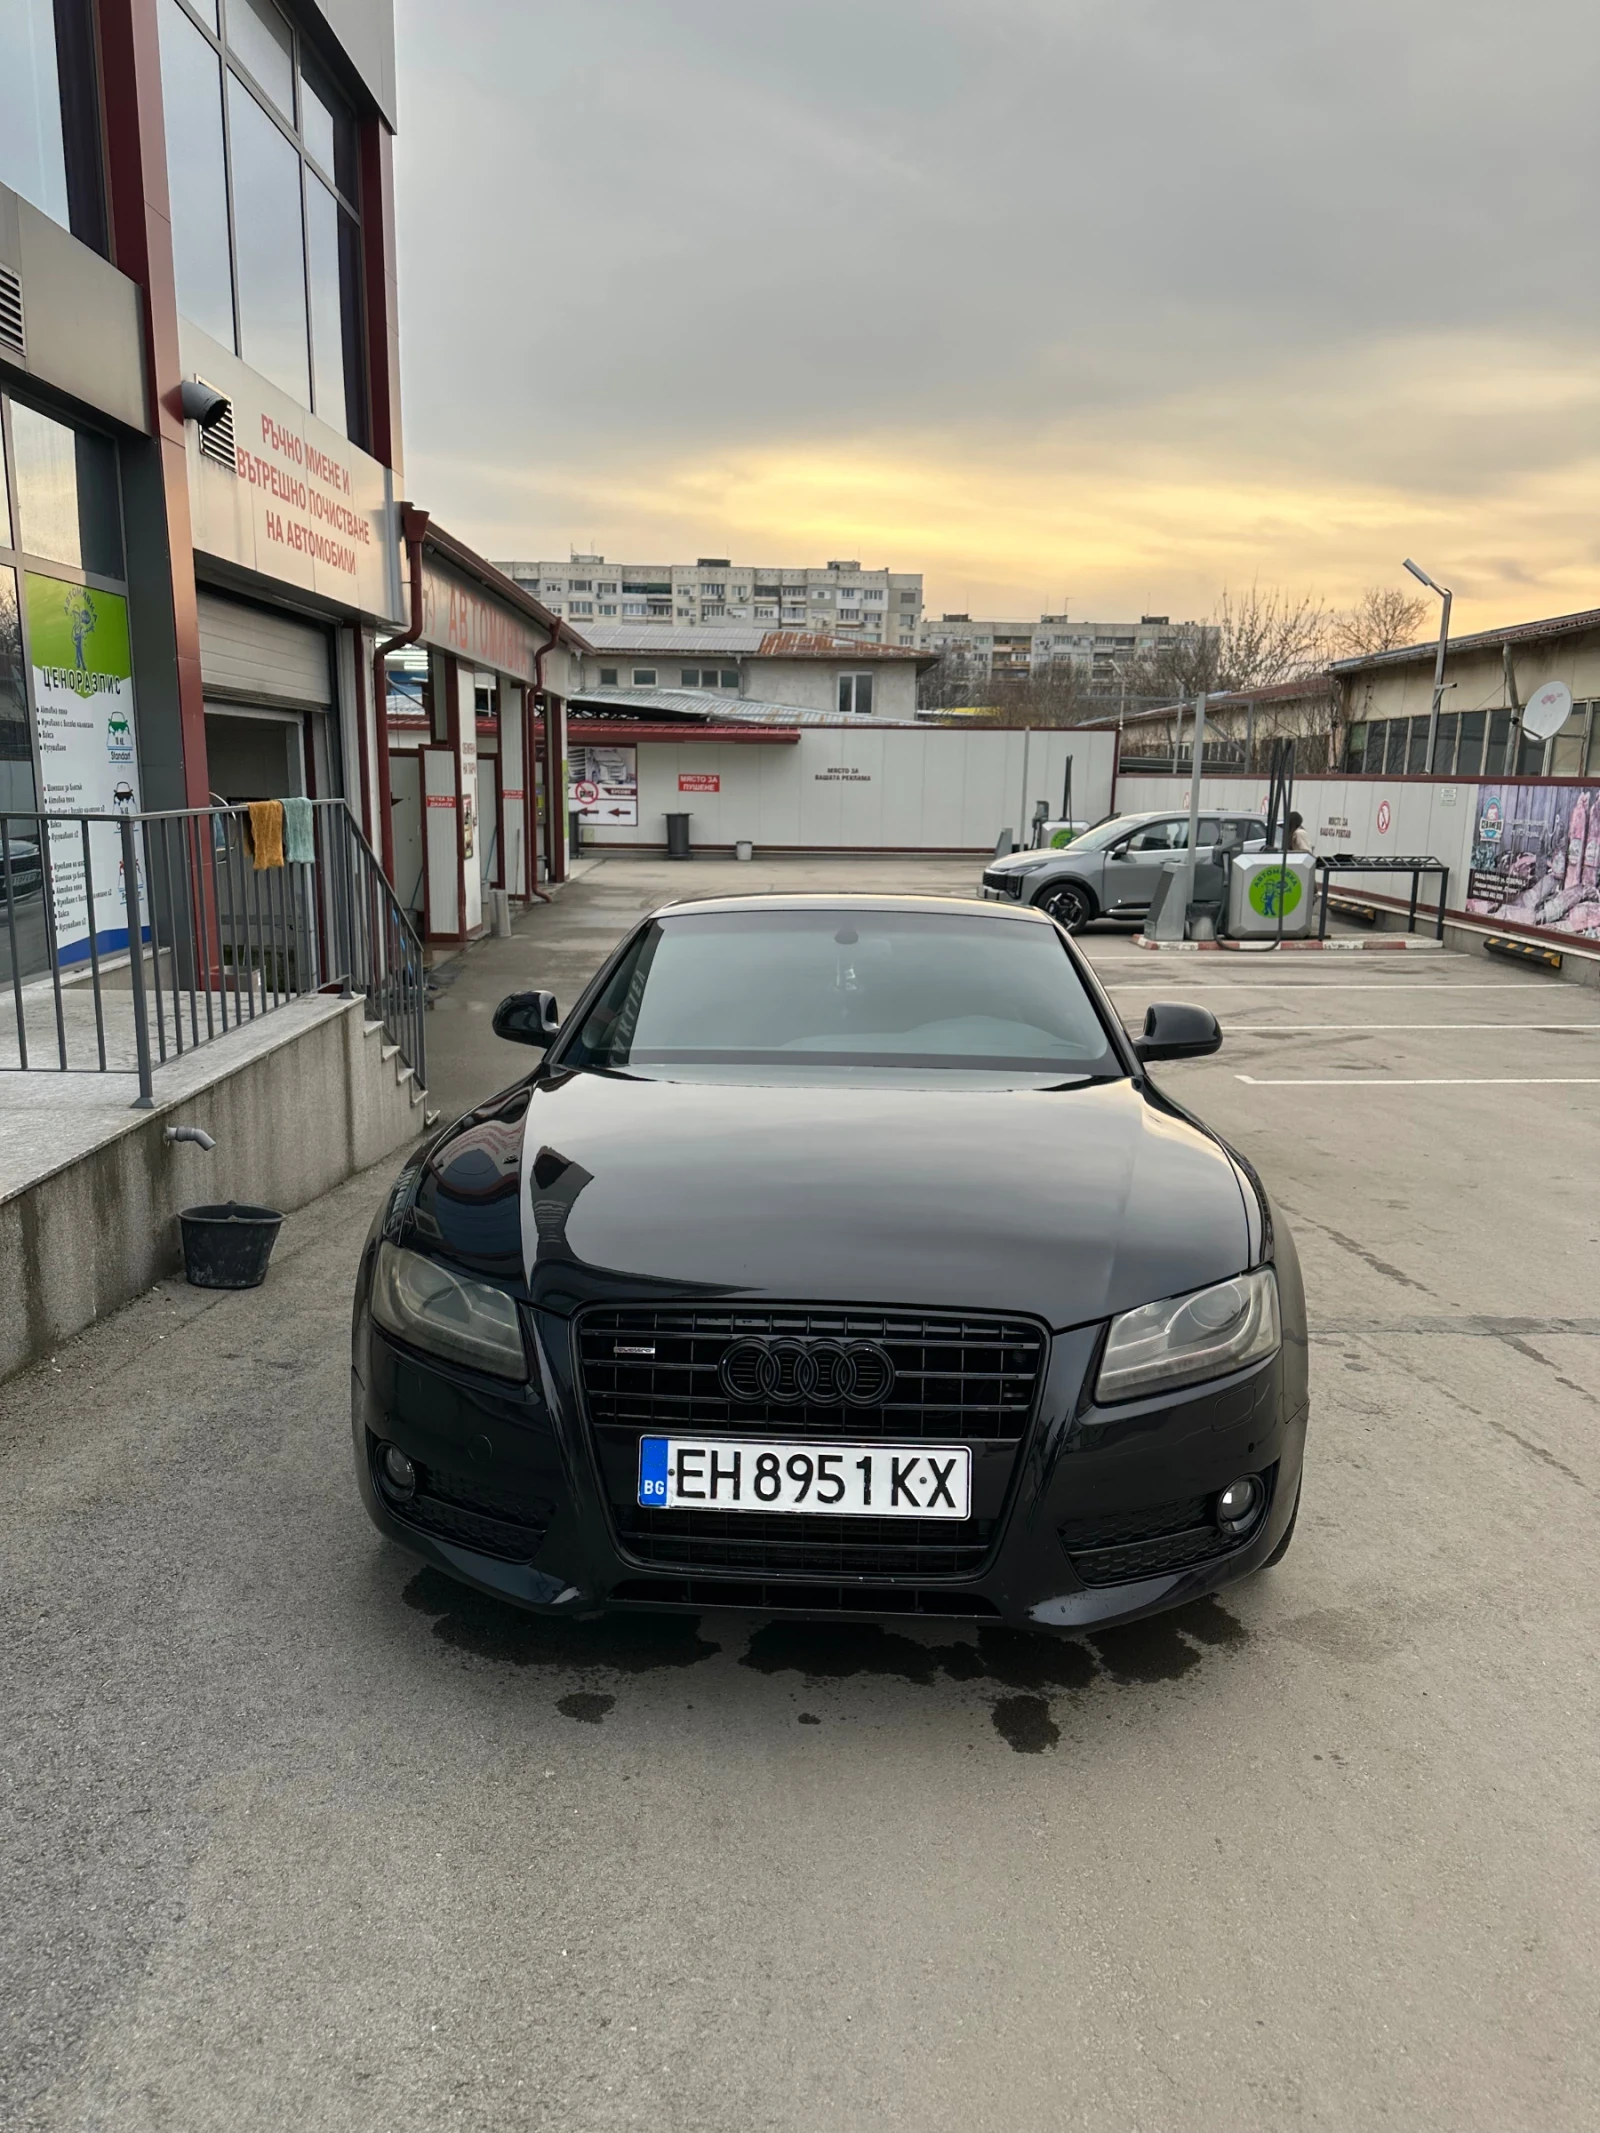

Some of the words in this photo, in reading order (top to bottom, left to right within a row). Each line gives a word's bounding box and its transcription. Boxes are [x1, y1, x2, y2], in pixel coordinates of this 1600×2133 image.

[261, 413, 303, 465] РЪЧНО
[304, 443, 342, 491] МИЕНЕ
[343, 468, 350, 496] И
[236, 446, 307, 511] ВЪТРЕШНО
[308, 487, 370, 545] ПОЧИСТВАНЕ
[266, 509, 284, 543] НА
[287, 520, 356, 576] АВТОМОБИЛИ
[448, 582, 529, 676] АВТОМИВКА
[43, 665, 121, 695] ЦЕНОРАЗПИС
[680, 775, 707, 783] МЯСТО
[683, 783, 715, 791] ПУШЕНЕ
[1254, 868, 1298, 888] АВТОМВКА
[643, 1480, 664, 1495] BG
[753, 1452, 872, 1505] 8951
